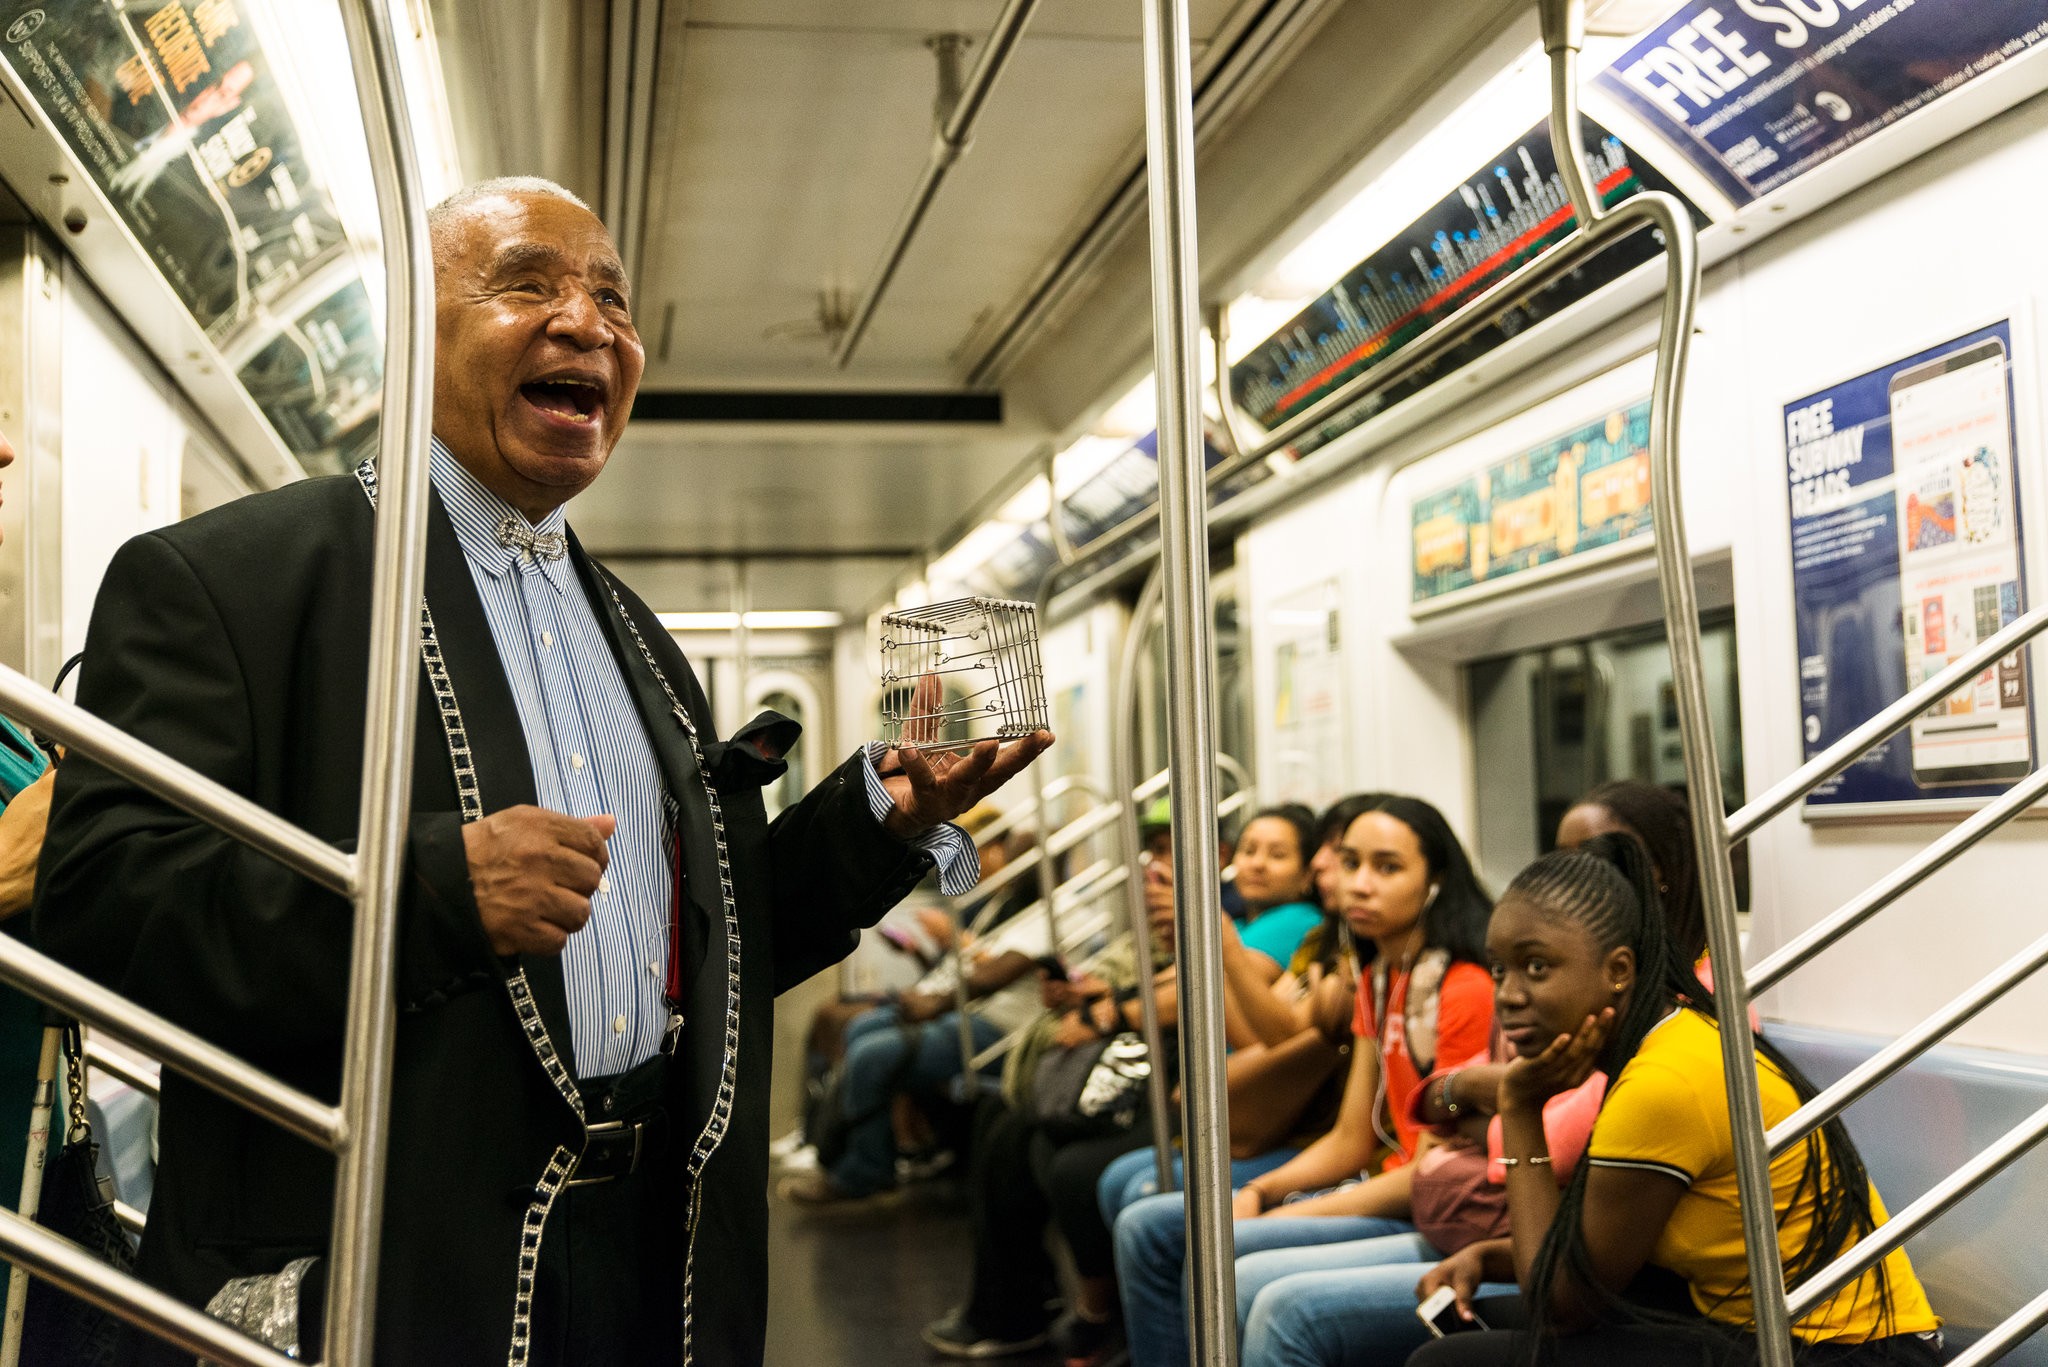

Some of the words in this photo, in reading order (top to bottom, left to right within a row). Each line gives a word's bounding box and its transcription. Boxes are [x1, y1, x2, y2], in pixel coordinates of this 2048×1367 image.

[16, 38, 57, 88] SUPPORTS
[144, 0, 211, 94] RECOGNIZE
[1621, 6, 1772, 122] FREE
[1812, 22, 1866, 65] underground
[1859, 4, 1898, 34] stations
[1972, 50, 2006, 73] reading
[2000, 38, 2025, 56] while
[2022, 29, 2041, 48] you
[1786, 398, 1835, 449] FREE
[1788, 424, 1865, 484] SUBWAY
